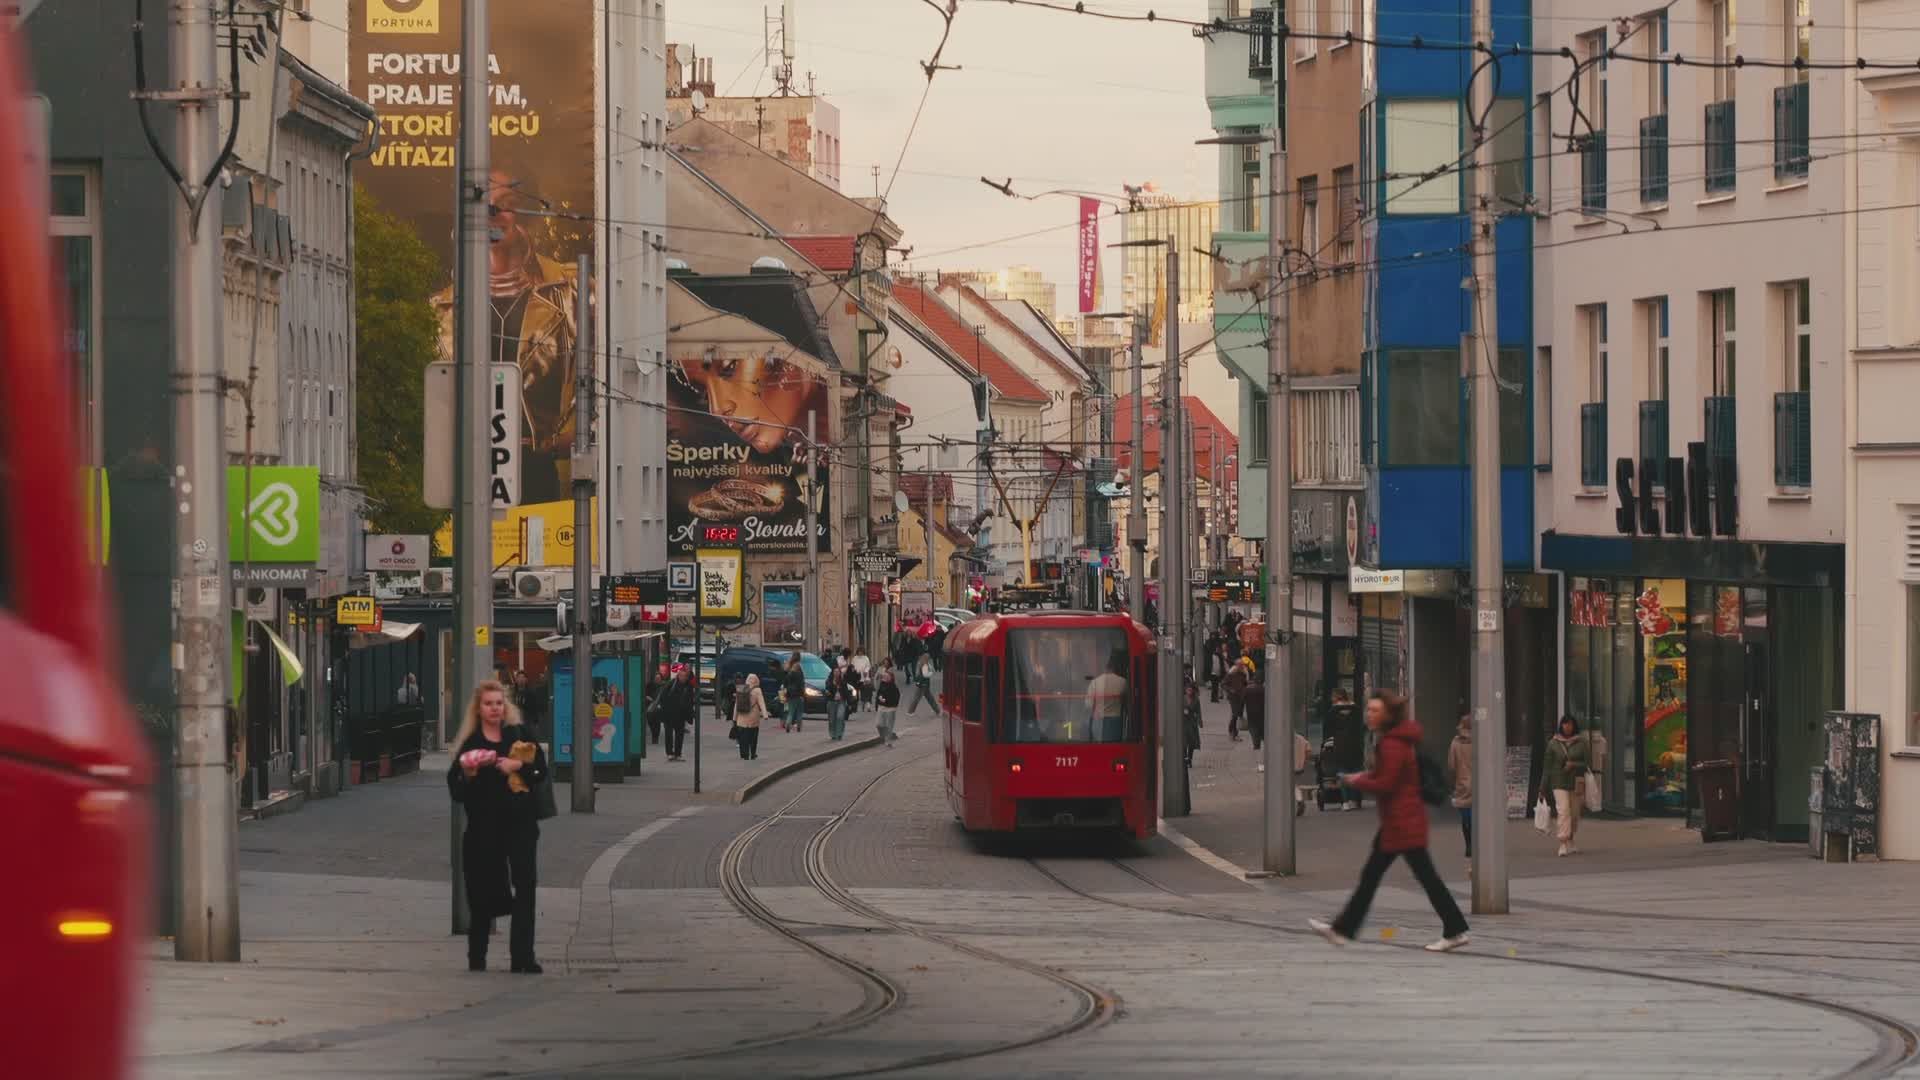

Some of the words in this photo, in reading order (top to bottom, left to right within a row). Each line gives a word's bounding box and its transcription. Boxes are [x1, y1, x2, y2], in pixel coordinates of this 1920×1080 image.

[372, 18, 433, 27] FORTUNA
[367, 53, 501, 74] FORTUA
[367, 84, 453, 105] PRAJE
[459, 111, 540, 136] HCÚ
[370, 141, 455, 167] VÍŤAZI
[667, 440, 750, 464] Šperky
[673, 464, 741, 479] najvyššej
[745, 464, 793, 477] kvality
[705, 528, 738, 541] 16:22
[743, 516, 827, 542] Slovaka
[342, 601, 370, 611] ATM
[1055, 757, 1078, 767] 7117
